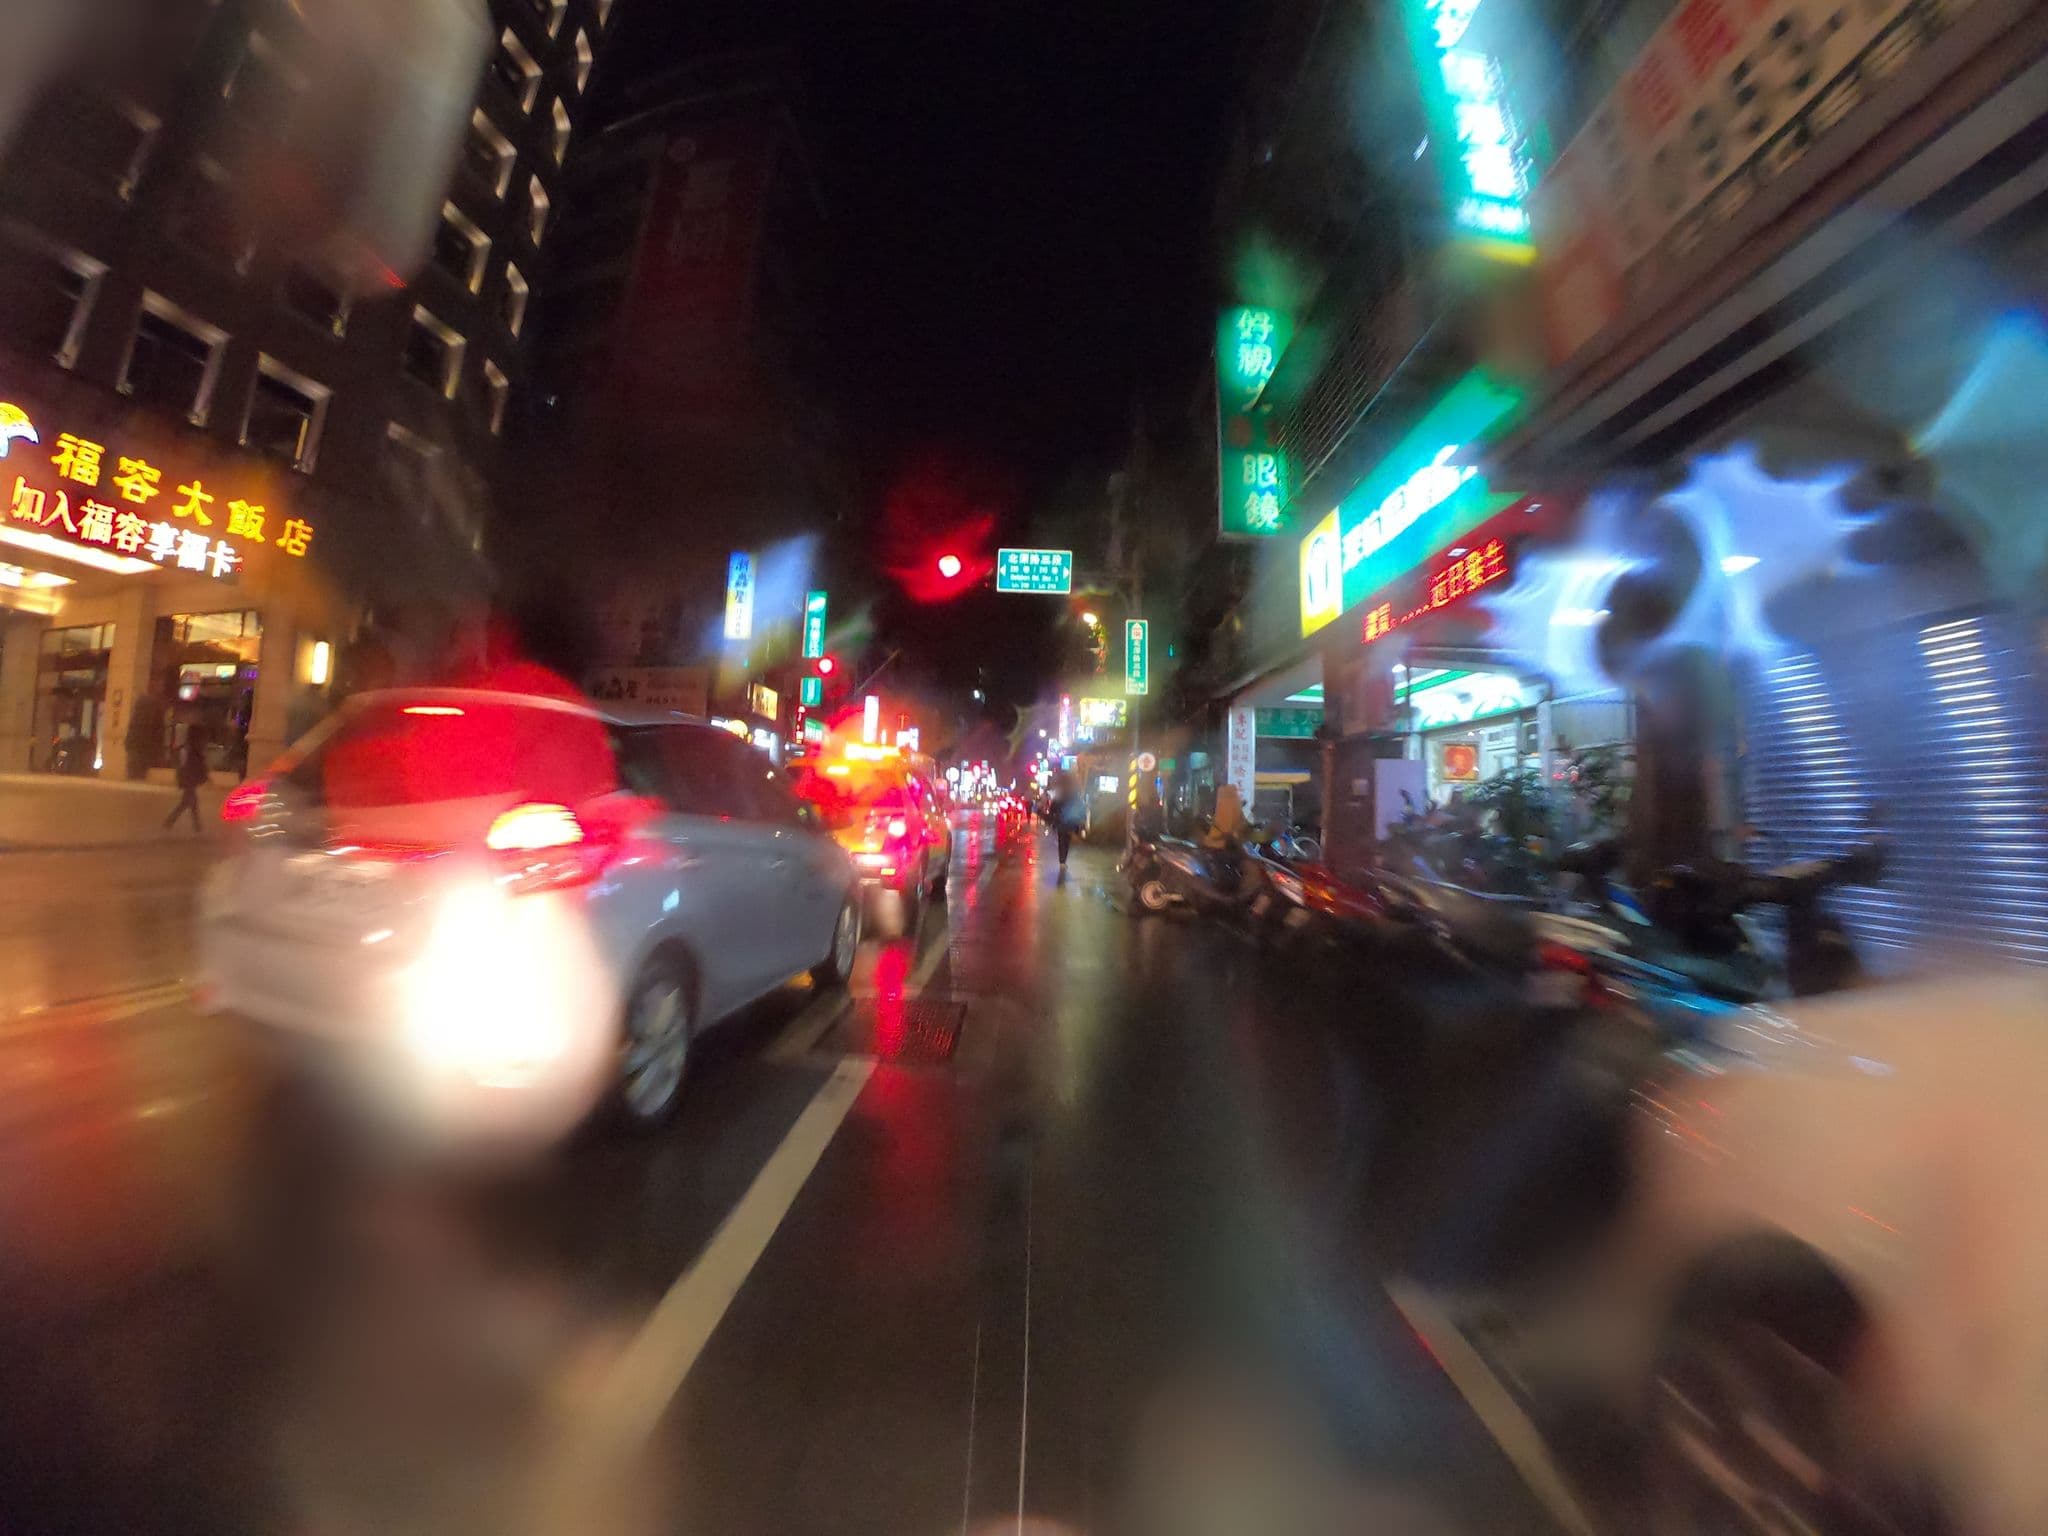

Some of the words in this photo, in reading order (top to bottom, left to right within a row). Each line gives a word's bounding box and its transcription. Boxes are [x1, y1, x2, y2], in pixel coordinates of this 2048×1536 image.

[11, 477, 239, 578] 加入福容享福卡
[51, 432, 314, 556] 福容大飯店
[1242, 454, 1278, 528] 眼鏡
